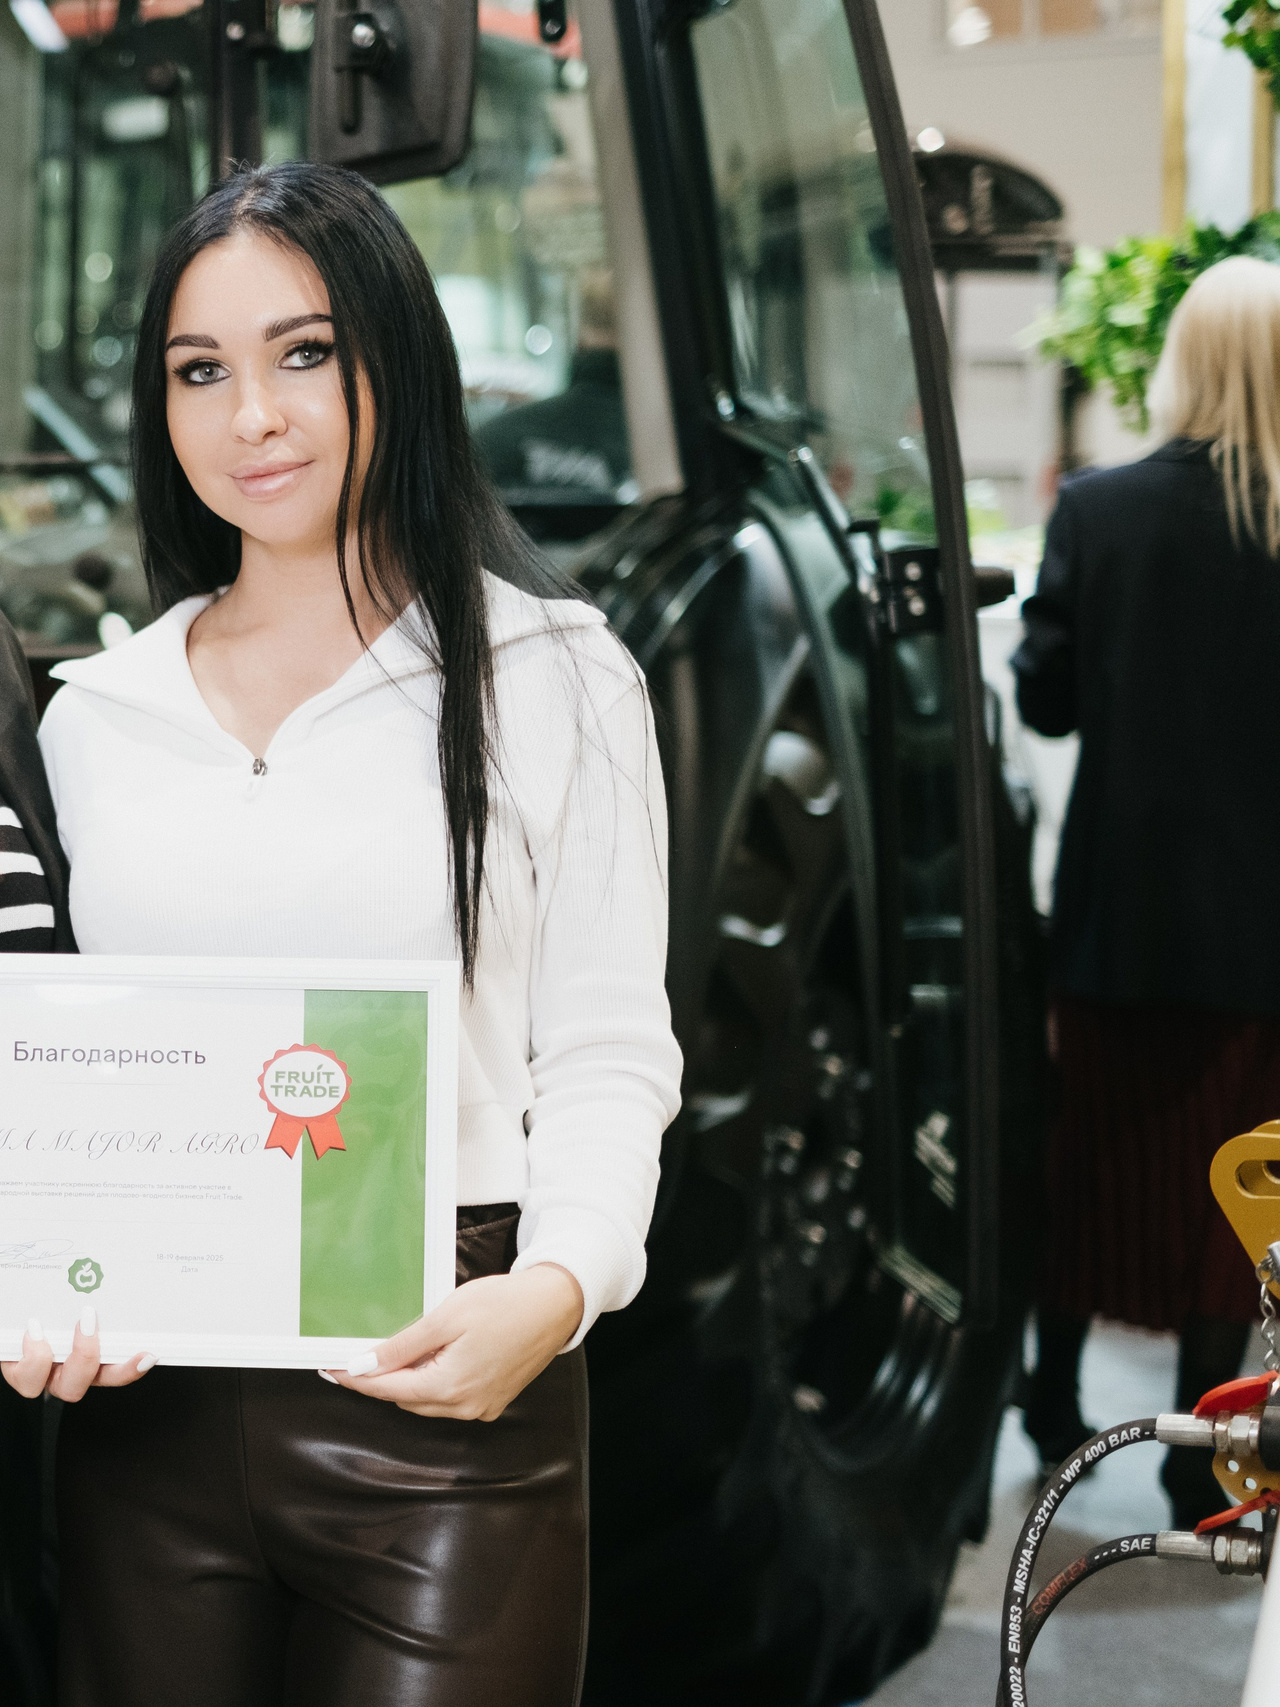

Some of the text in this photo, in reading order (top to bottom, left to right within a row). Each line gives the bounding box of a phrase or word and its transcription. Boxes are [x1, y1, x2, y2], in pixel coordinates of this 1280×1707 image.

[13, 1040, 207, 1069] Благодарность
[270, 1084, 340, 1098] TRADE
[24, 1181, 59, 1189] участнику
[102, 1181, 155, 1190] благодарность
[63, 1190, 95, 1198] решений
[175, 1192, 204, 1200] бизнеса
[156, 1253, 224, 1262] 18-19 февраля 2025
[22, 1261, 63, 1270] Демиденко
[181, 1265, 198, 1273] Дата
[1008, 1604, 1023, 1654] EN853
[1060, 1458, 1083, 1484] WP
[1084, 1440, 1107, 1463] 400
[1108, 1426, 1141, 1448] BAR
[1120, 1537, 1152, 1553] SAE
